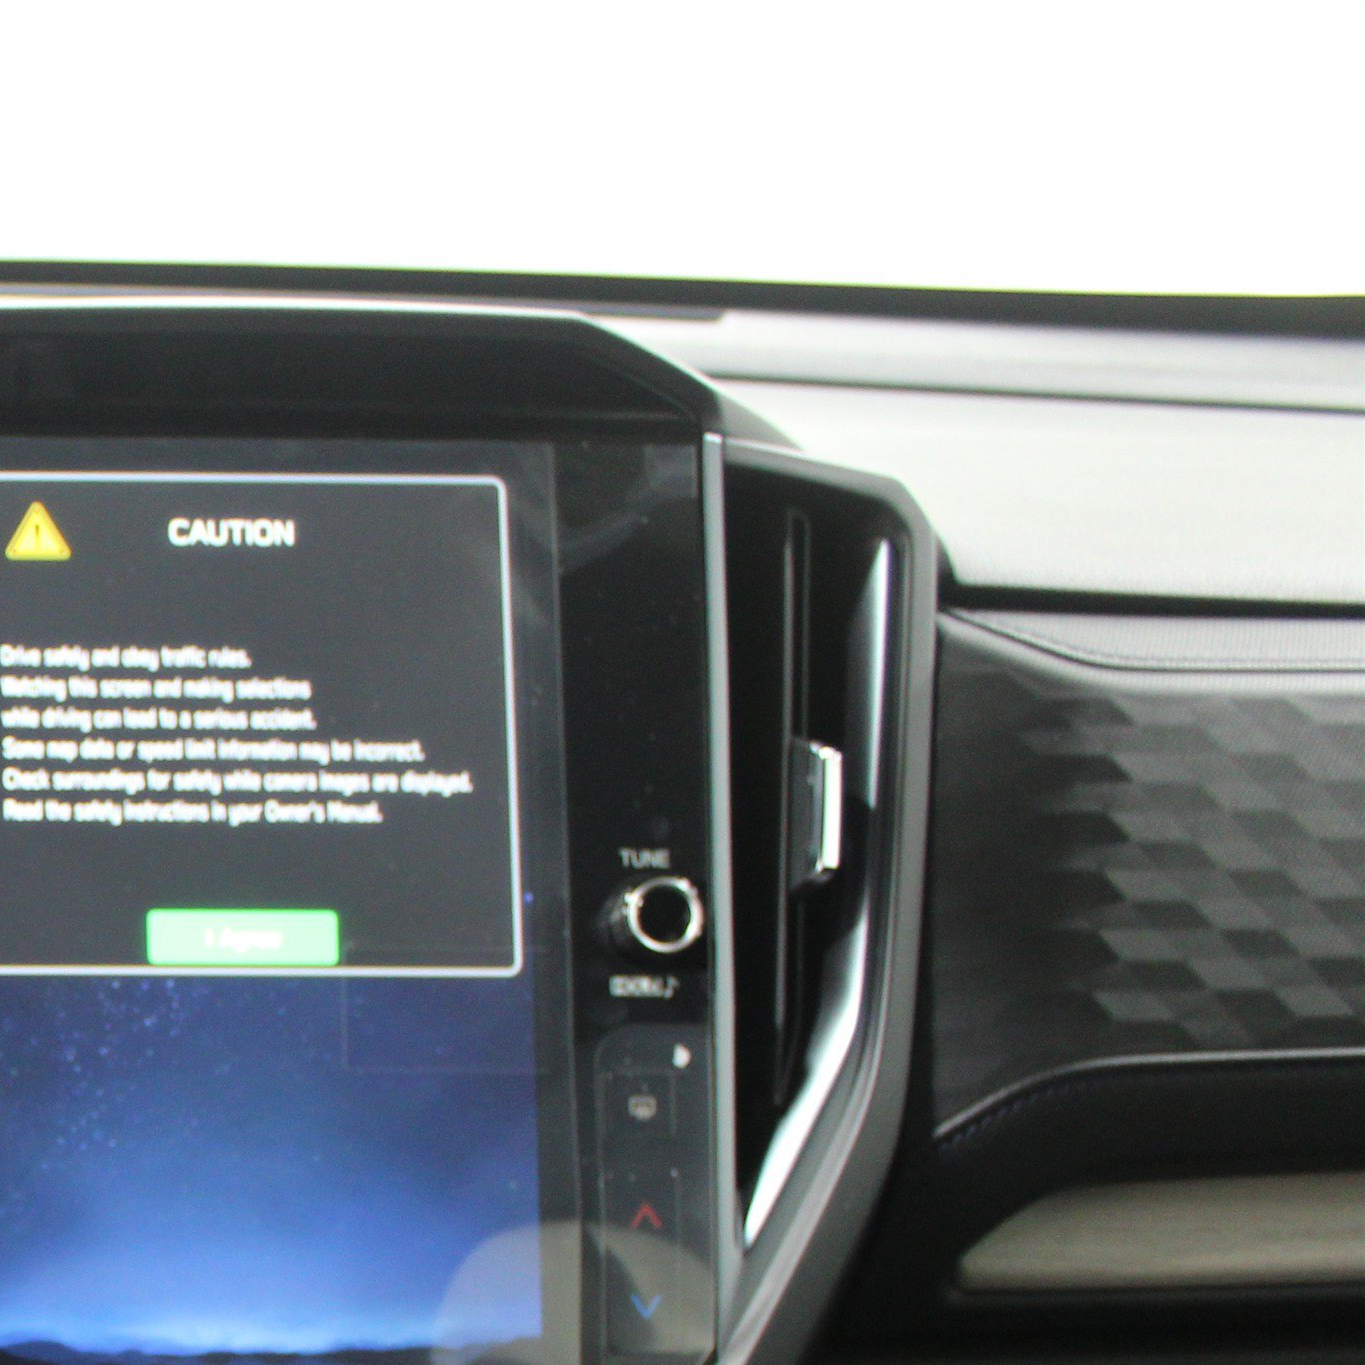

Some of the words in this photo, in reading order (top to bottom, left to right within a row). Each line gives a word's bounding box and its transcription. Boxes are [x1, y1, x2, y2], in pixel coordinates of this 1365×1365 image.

[168, 517, 296, 548] CAUTION
[0, 644, 41, 667] Drive
[43, 644, 90, 672] safely
[91, 645, 119, 668] and
[121, 645, 160, 672] obey
[161, 645, 207, 668] traffic
[0, 674, 66, 702] Watching
[68, 675, 98, 698] this
[99, 678, 151, 698] screen
[153, 676, 182, 699] and
[183, 676, 234, 703] making
[235, 676, 312, 700] selections
[1, 705, 40, 729] while
[41, 705, 92, 733] driving
[93, 708, 122, 729] can
[123, 706, 157, 729] lead
[159, 706, 178, 730] to
[179, 709, 192, 730] a
[193, 706, 248, 730] serious
[2, 735, 45, 760] Some
[46, 740, 78, 763] map
[79, 737, 115, 760] data
[116, 741, 135, 760] or
[137, 738, 184, 763] speed
[217, 737, 297, 761] information
[299, 741, 330, 766] may
[331, 738, 352, 761] be
[2, 766, 50, 791] Check
[52, 768, 145, 795] surroundings
[147, 768, 171, 791] for
[173, 768, 222, 796] safety
[223, 768, 262, 792] while
[263, 772, 318, 793] camera
[319, 769, 370, 797] images
[371, 772, 399, 793] are
[2, 798, 43, 822] Read
[45, 799, 72, 822] the
[73, 799, 122, 827] safety
[123, 799, 209, 823] instructions
[210, 800, 226, 823] in
[227, 803, 263, 827] your
[620, 849, 670, 869] TUNE
